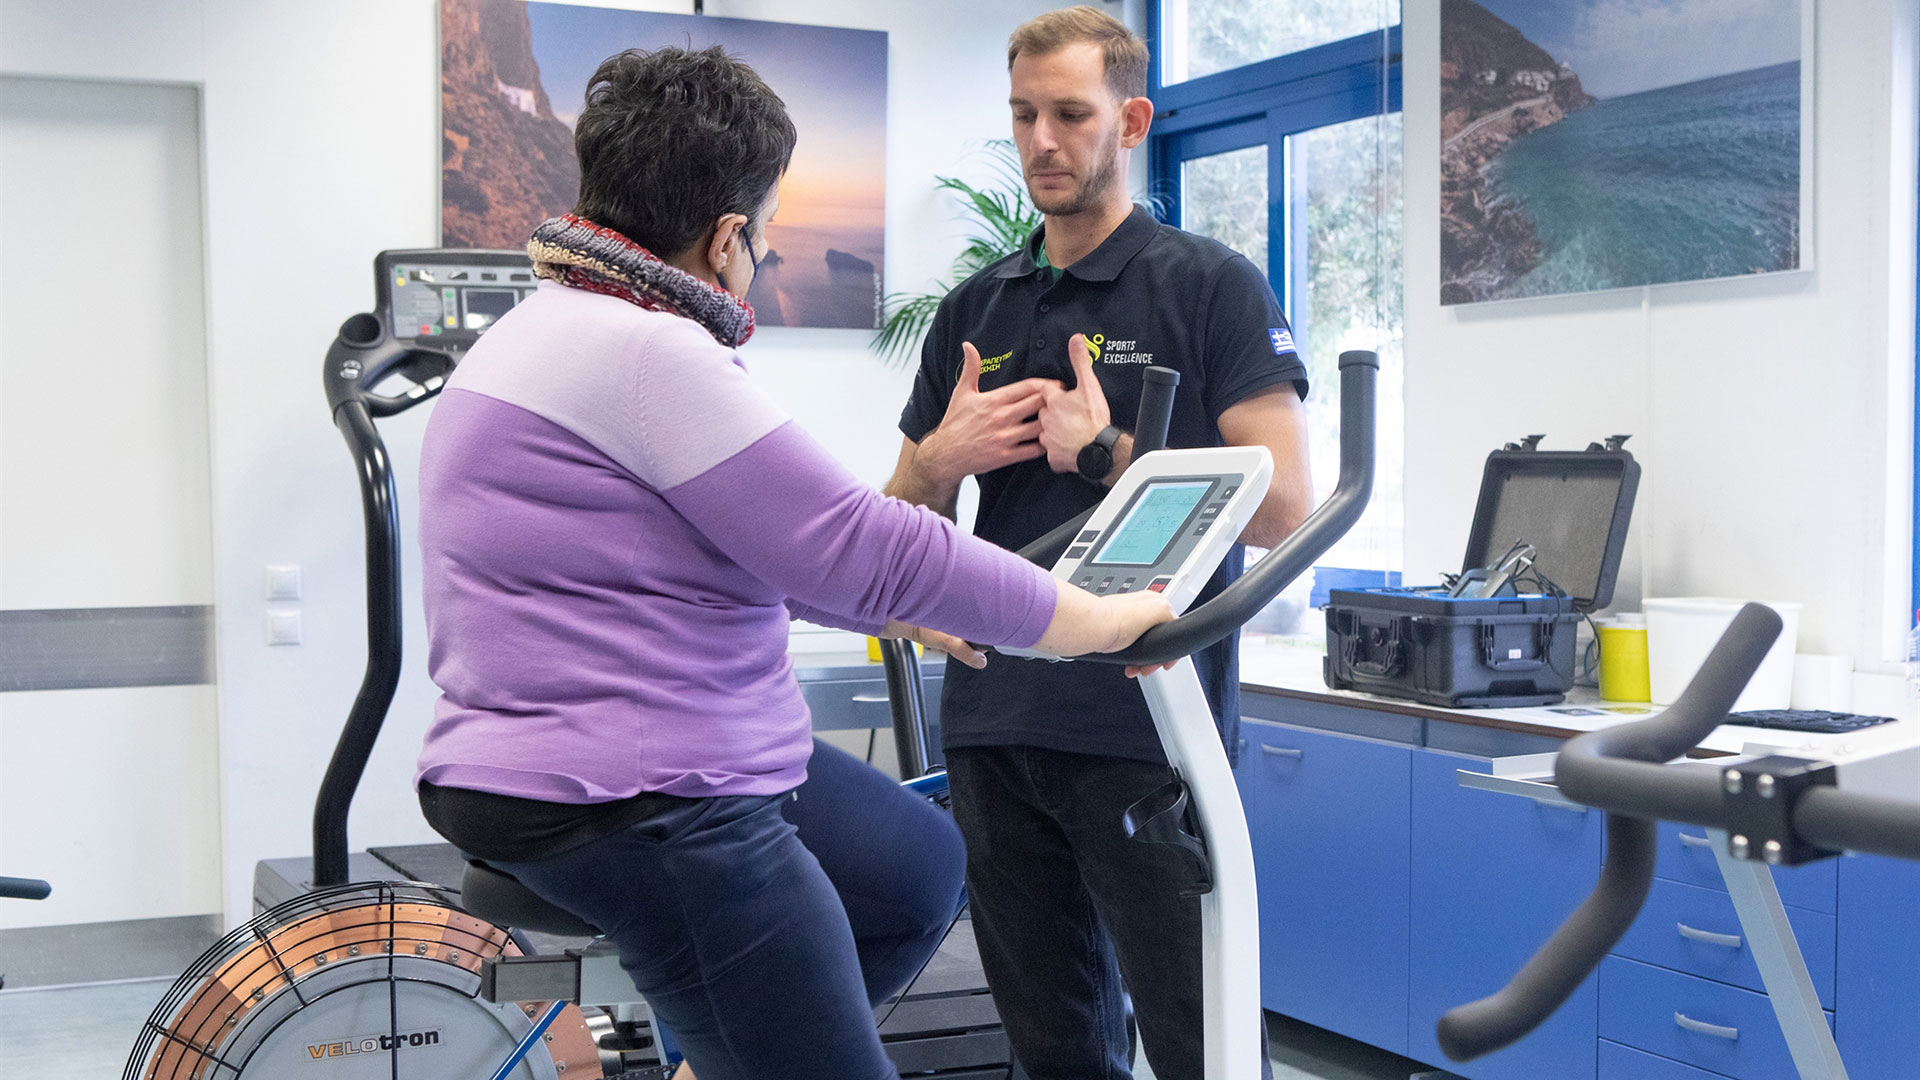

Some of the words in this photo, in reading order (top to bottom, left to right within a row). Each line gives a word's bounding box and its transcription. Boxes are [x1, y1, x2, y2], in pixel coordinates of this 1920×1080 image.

[1106, 340, 1136, 351] SPORTS
[1104, 352, 1153, 364] EXCELLENCE
[307, 1030, 439, 1059] VELOtron
